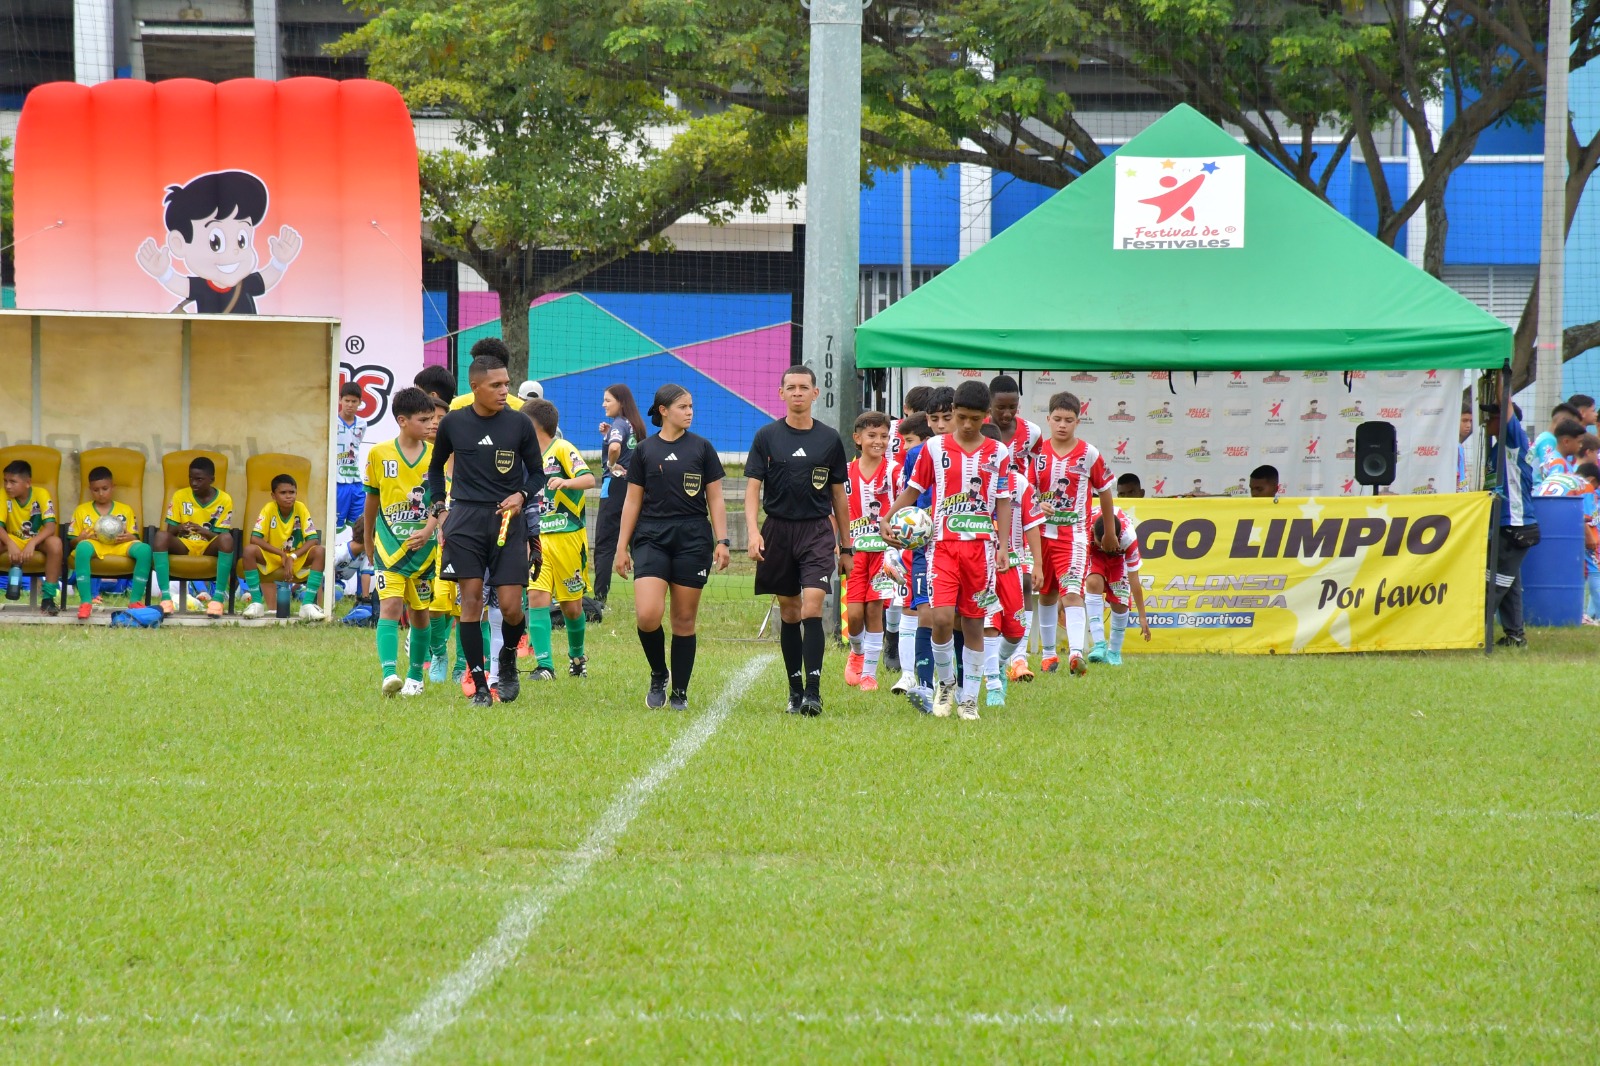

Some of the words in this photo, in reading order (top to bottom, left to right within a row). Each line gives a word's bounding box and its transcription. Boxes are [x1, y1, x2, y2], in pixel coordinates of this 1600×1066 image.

[1135, 226, 1198, 238] Festival
[1202, 226, 1220, 237] de
[941, 451, 951, 469] 6
[382, 460, 398, 478] 18
[182, 502, 193, 516] 15
[84, 515, 92, 527] 4
[270, 516, 277, 529] 6
[948, 518, 994, 530] Colanta
[1135, 518, 1217, 560] GO
[1229, 515, 1452, 559] LIMPIO
[1164, 574, 1288, 591] ALONSO
[1195, 595, 1288, 609] PINEDA
[1318, 579, 1365, 610] Por
[1374, 577, 1448, 616] favor
[1128, 613, 1174, 625] ventos
[1177, 613, 1253, 627] Deportivos
